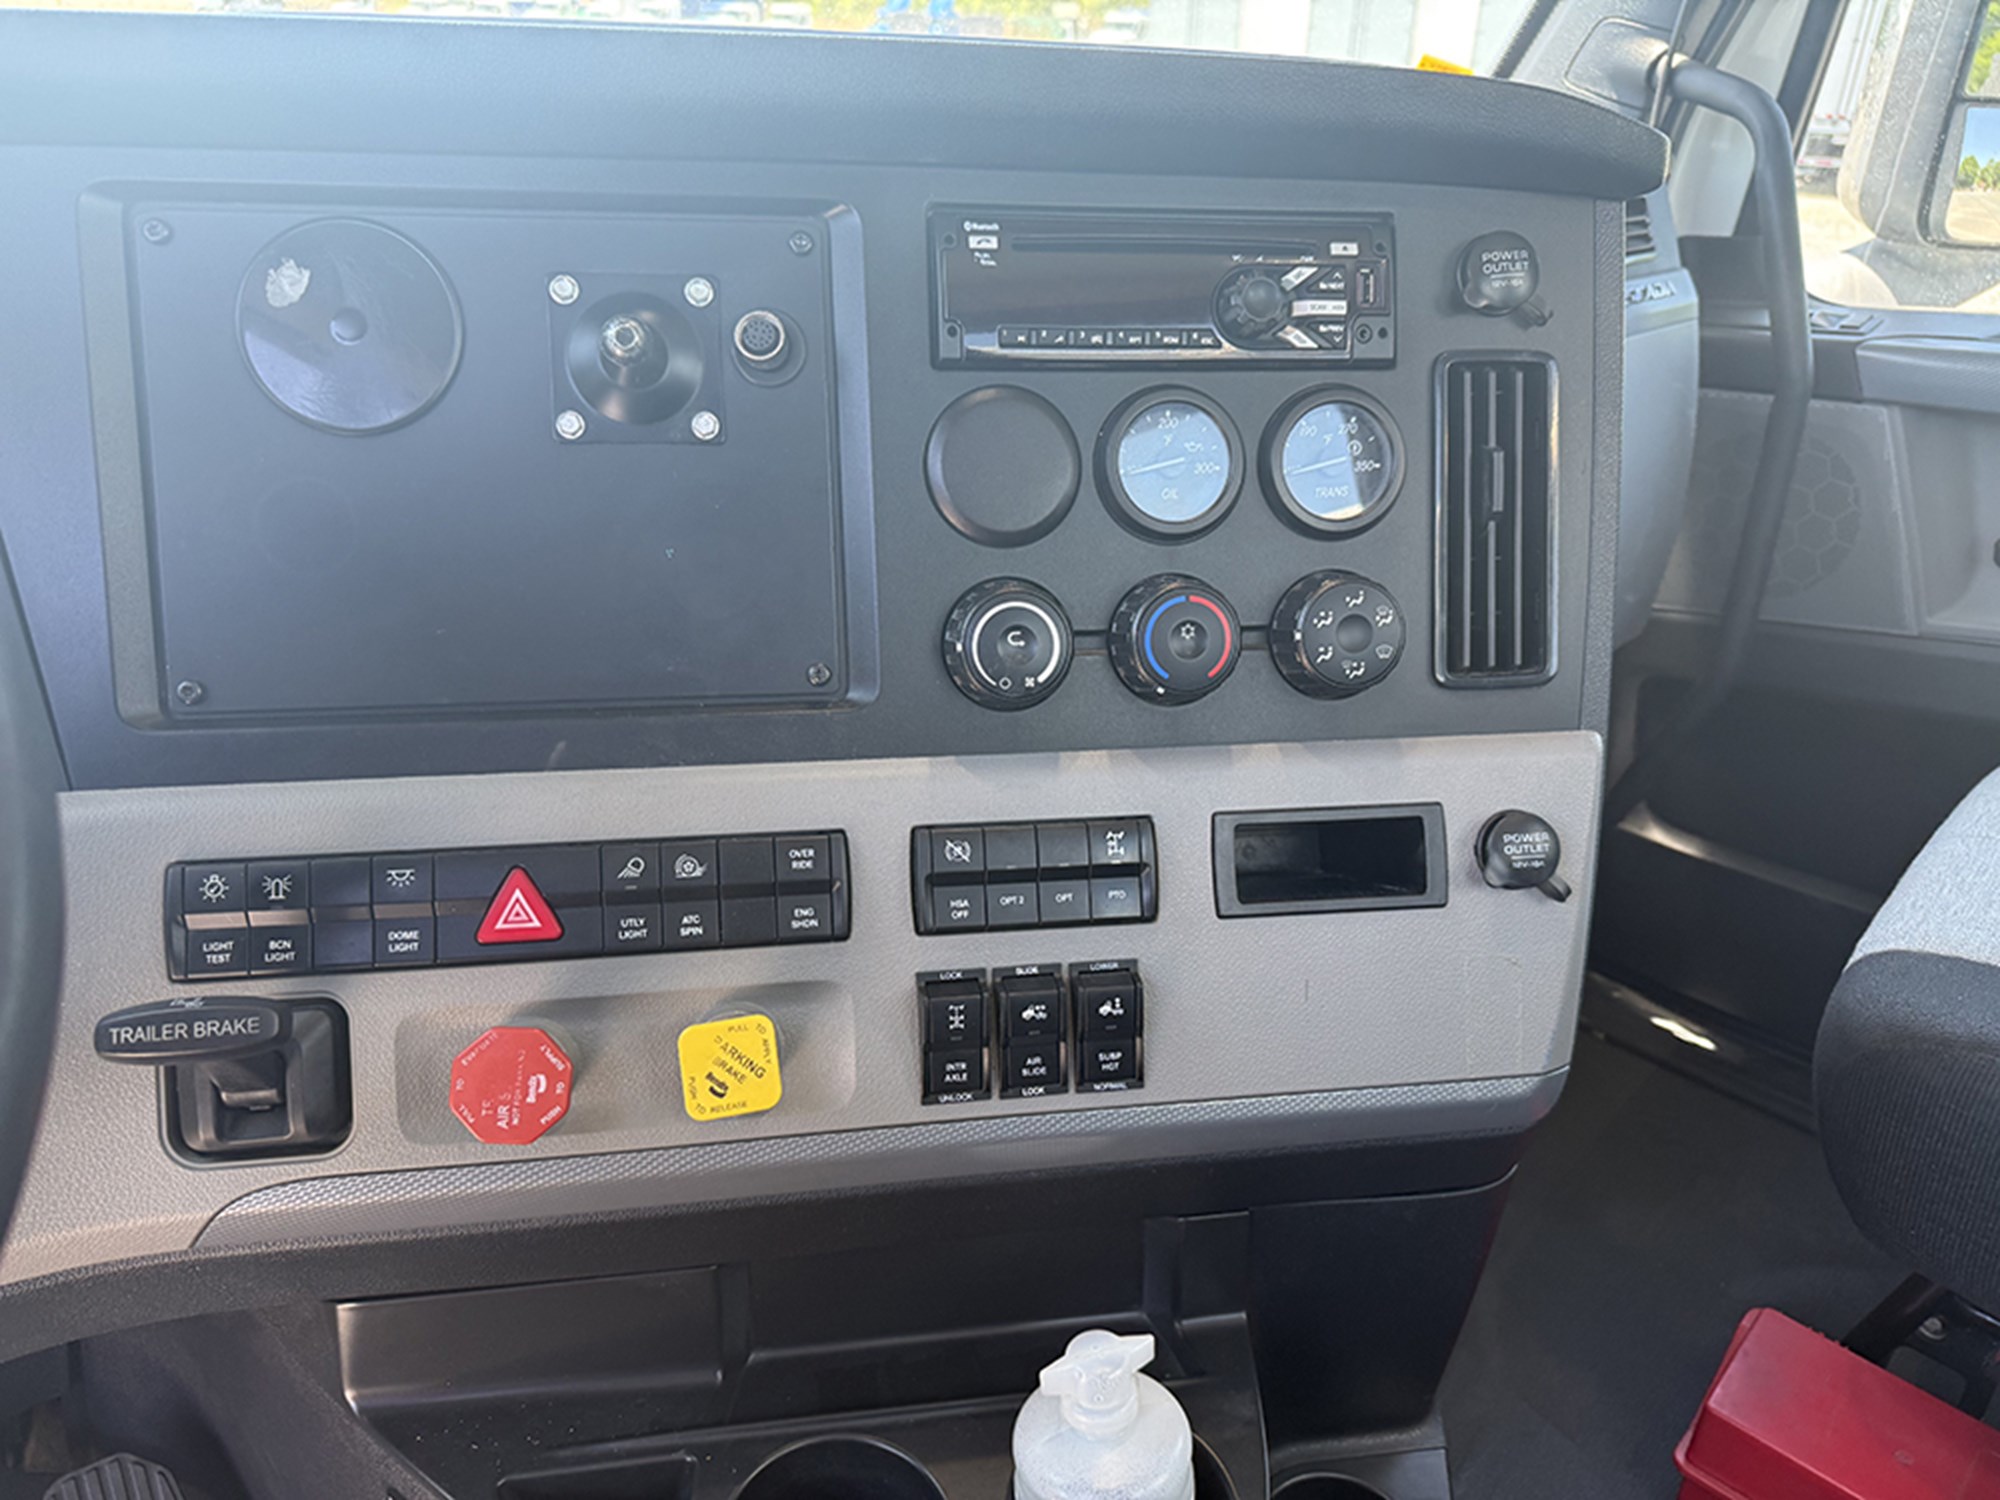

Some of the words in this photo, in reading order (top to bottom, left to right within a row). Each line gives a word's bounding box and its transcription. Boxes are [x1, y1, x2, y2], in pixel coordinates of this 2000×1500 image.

[1482, 250, 1529, 262] POWER
[1482, 261, 1529, 274] OUTLET
[1157, 417, 1180, 429] 200
[1338, 423, 1358, 434] 270
[1354, 459, 1374, 472] 350
[1161, 488, 1179, 500] OIL
[1315, 486, 1349, 498] TRANS
[1503, 832, 1549, 843] POWER
[789, 849, 815, 859] OVER
[1503, 843, 1550, 855] OUTLET
[791, 860, 814, 870] RIDE
[1055, 893, 1073, 903] OPT
[1108, 890, 1127, 900] PTO
[1000, 896, 1017, 906] OPT
[794, 908, 814, 918] ENG
[951, 909, 969, 920] OFF
[621, 918, 646, 929] UTLY
[681, 915, 700, 925] ATC
[388, 931, 420, 941] DOME
[618, 928, 648, 941] LIGHT
[680, 926, 703, 937] SPIN
[203, 941, 234, 952] LIGHT
[269, 940, 292, 950] BCN
[388, 942, 419, 953] LIGHT
[206, 954, 231, 964] TEST
[264, 951, 296, 963] LIGHT
[1016, 966, 1039, 976] SLIDE
[1090, 962, 1119, 972] LOWER
[939, 971, 963, 981] LOCK
[109, 1022, 189, 1046] TRAILER
[193, 1016, 261, 1040] BRAKE
[756, 1023, 767, 1035] TO
[762, 1038, 772, 1064] APPLY
[539, 1044, 566, 1072] SUPPLY
[713, 1035, 767, 1080] PARKING
[1026, 1056, 1042, 1067] AIR
[1098, 1051, 1122, 1062] SUSP
[712, 1056, 747, 1085] BRAKE
[945, 1062, 967, 1072] INTR
[1021, 1066, 1047, 1077] SLIDE
[944, 1072, 968, 1083] AXLE
[556, 1081, 566, 1095] TO
[1022, 1086, 1046, 1097] LOCK
[1093, 1082, 1127, 1091] NORMAL
[938, 1093, 973, 1104] UNLOCK
[695, 1103, 707, 1115] TO
[710, 1100, 748, 1114] RELEASE
[458, 1104, 476, 1124] PULL
[496, 1105, 511, 1130] AIR
[540, 1105, 562, 1126] PUSH
